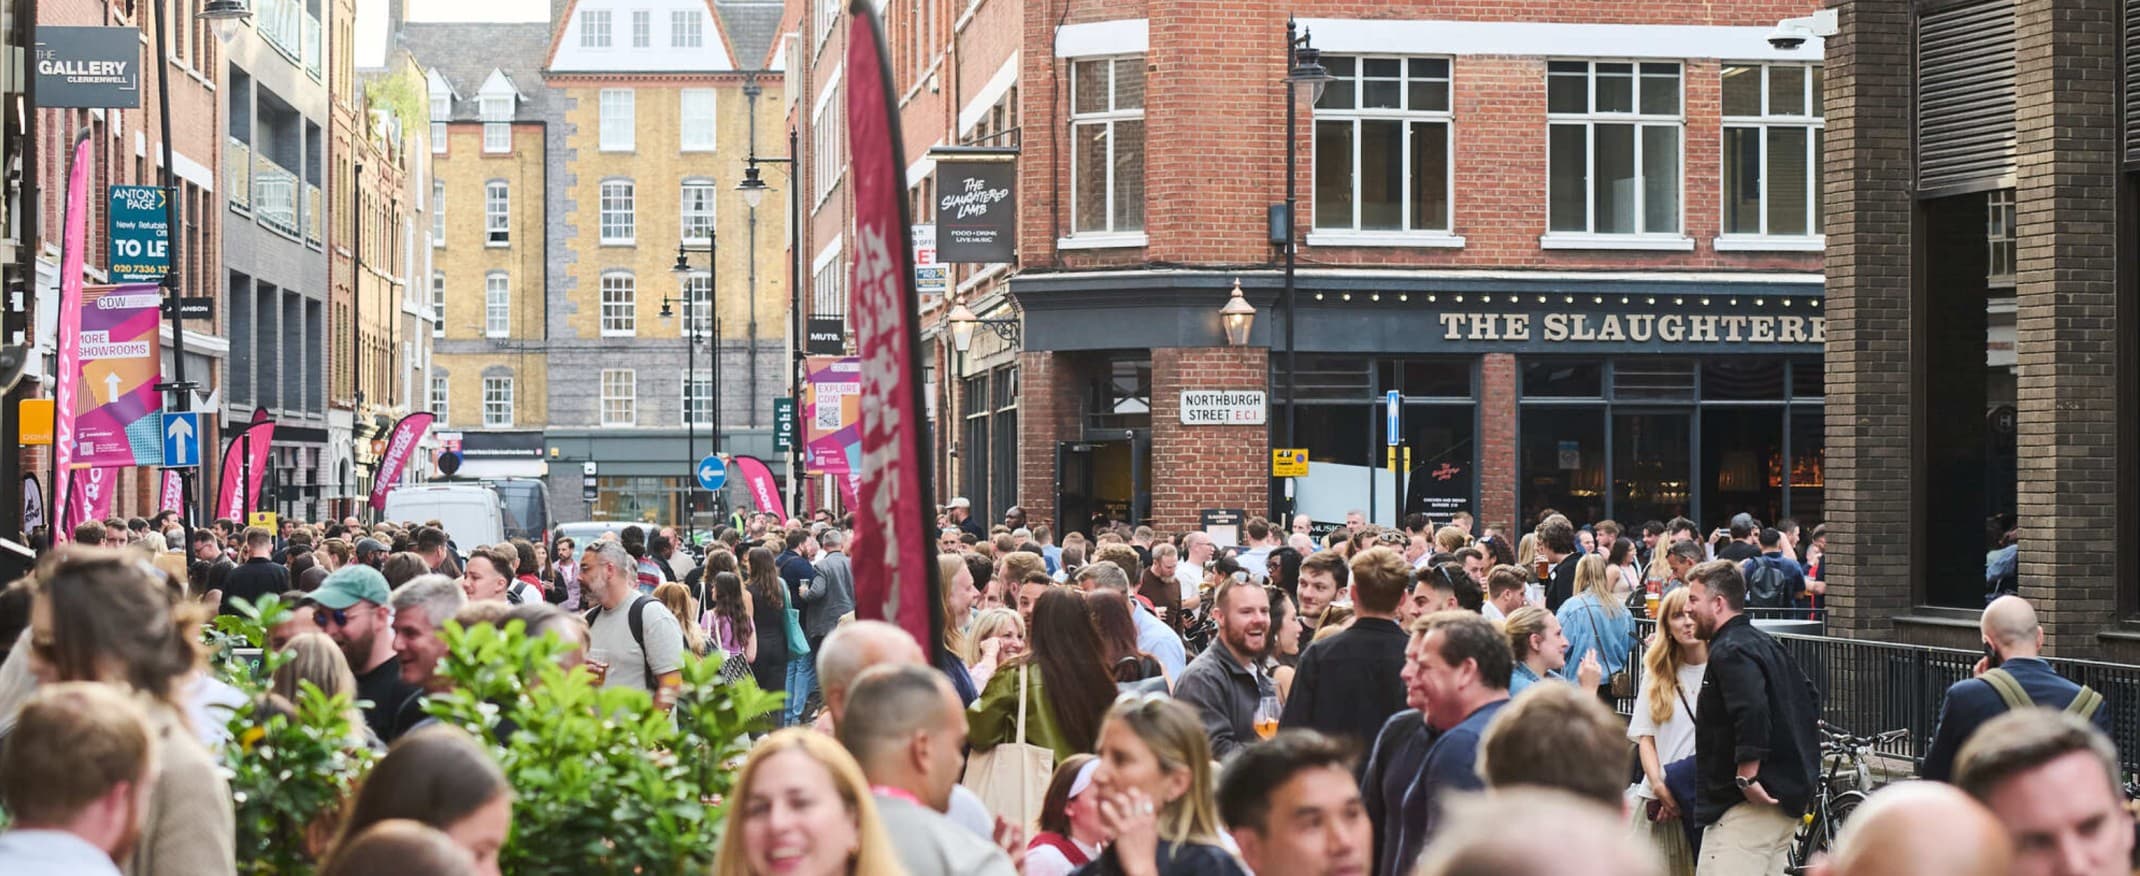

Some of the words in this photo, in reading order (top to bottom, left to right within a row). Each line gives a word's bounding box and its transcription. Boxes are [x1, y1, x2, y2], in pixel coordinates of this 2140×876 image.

[38, 60, 127, 75] GALLERY
[963, 178, 984, 192] THE
[113, 189, 155, 199] ANTON
[941, 189, 1008, 210] SLAUGHTERED
[126, 200, 155, 209] PAGE
[957, 204, 987, 219] LAMB
[115, 240, 141, 256] TO
[113, 264, 131, 272] 020
[98, 297, 126, 308] CDW
[1440, 313, 1529, 340] THE
[78, 344, 146, 357] SHOWROOMS
[818, 384, 857, 393] EXPLORE
[1186, 395, 1261, 406] NORTHBURGH
[1189, 409, 1231, 420] STREET
